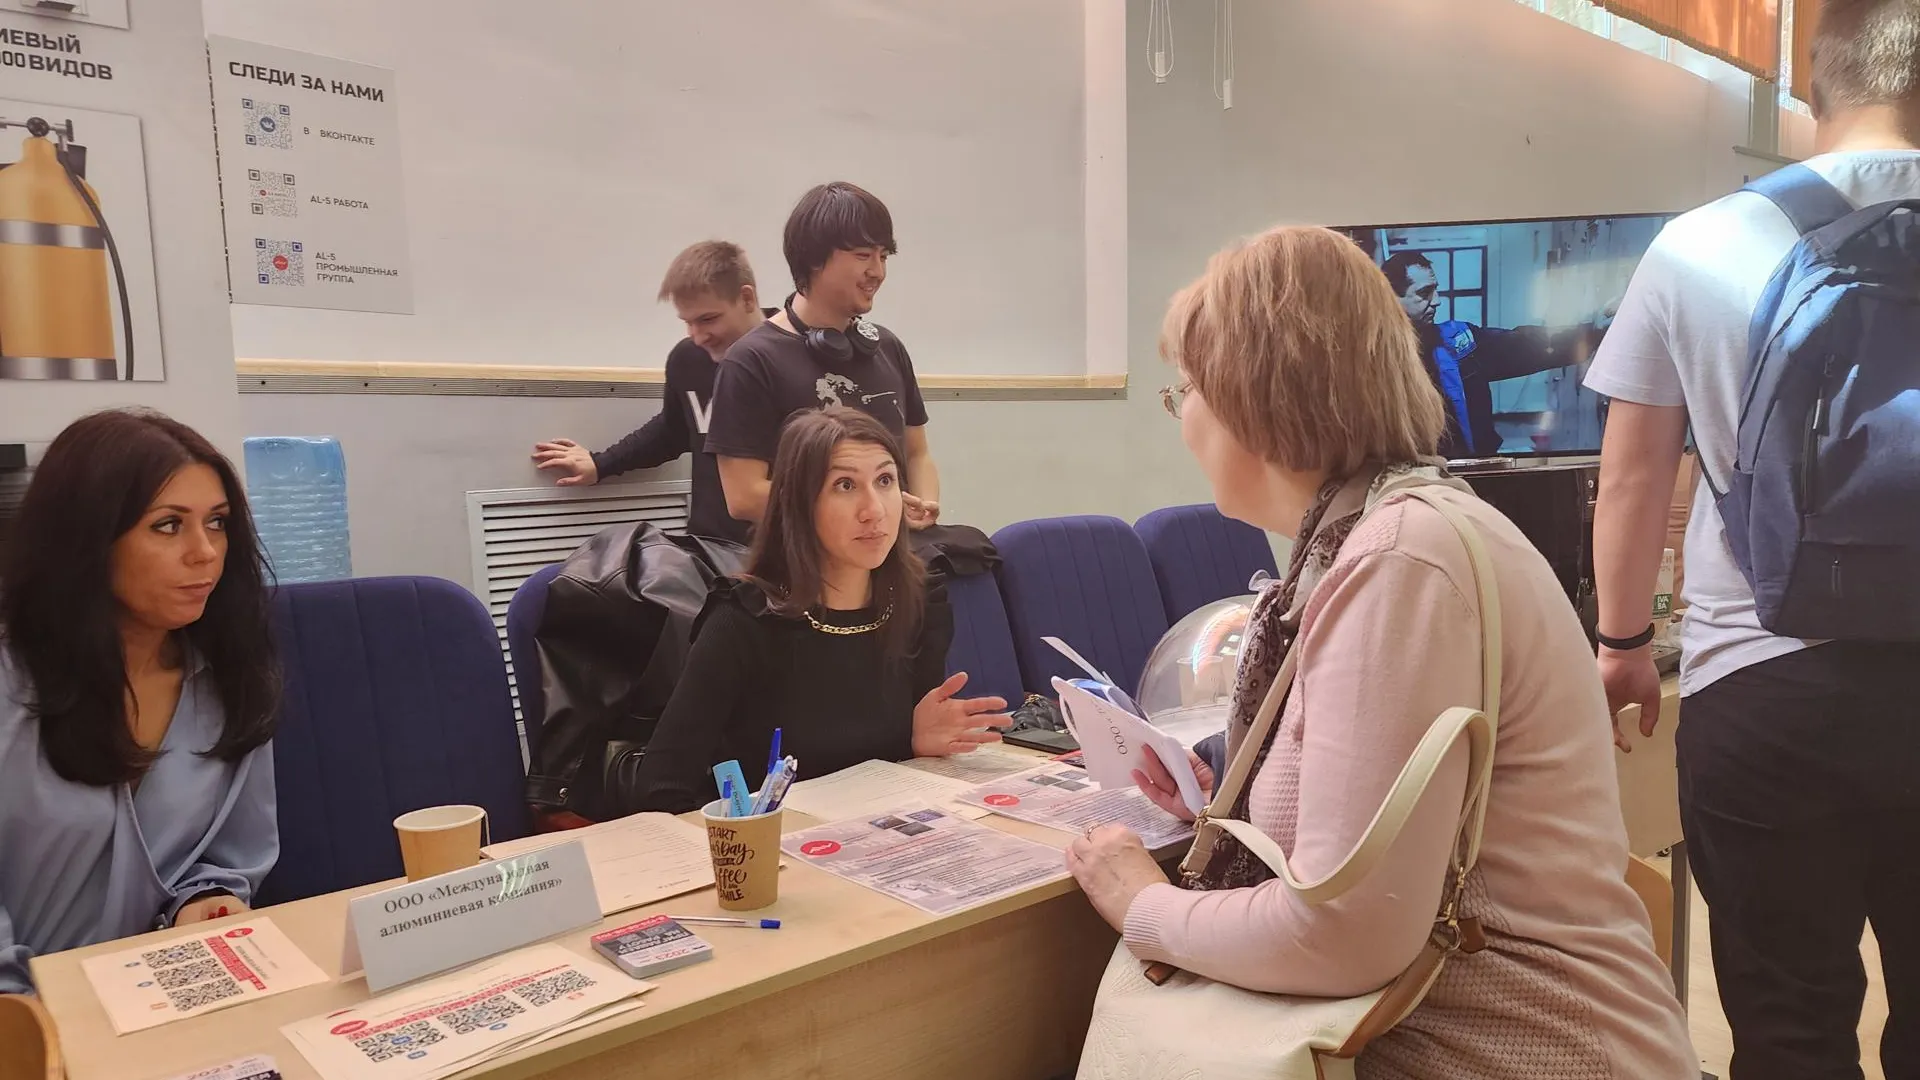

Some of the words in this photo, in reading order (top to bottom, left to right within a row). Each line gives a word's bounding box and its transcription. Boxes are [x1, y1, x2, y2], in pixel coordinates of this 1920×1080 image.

[28, 54, 113, 80] ВИДОВ
[229, 61, 296, 86] СЛЕДИ
[300, 74, 326, 92] ЗА
[331, 80, 384, 102] НАМИ
[303, 127, 310, 135] В
[320, 129, 376, 146] ВКОНТАКТЕ
[333, 198, 369, 209] РАБОТА
[315, 252, 337, 261] AL-5
[316, 262, 399, 277] ПРОМЫШЛЕННАЯ
[317, 273, 355, 284] ГРУППА
[384, 892, 425, 914] ООО
[379, 899, 485, 938] алюминиевая
